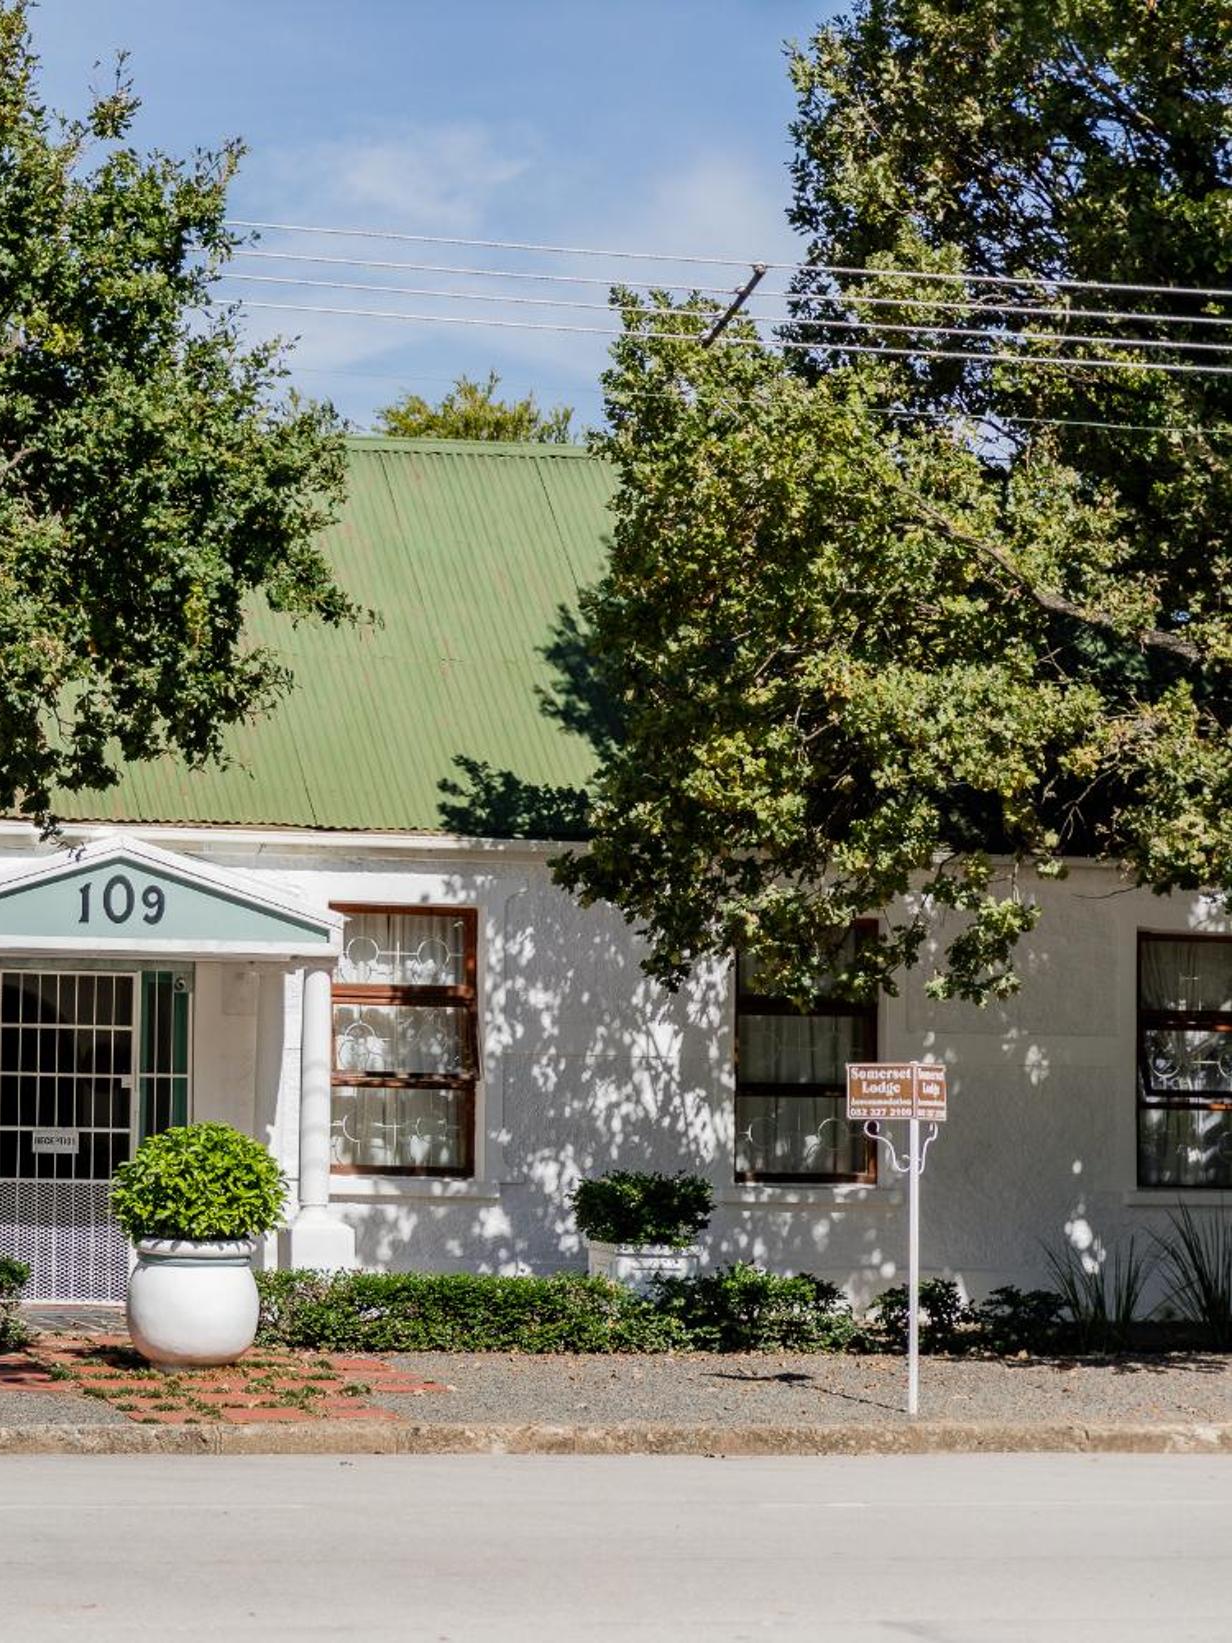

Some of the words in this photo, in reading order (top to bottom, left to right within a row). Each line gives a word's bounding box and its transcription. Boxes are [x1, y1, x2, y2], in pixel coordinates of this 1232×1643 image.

[78, 874, 165, 925] 109
[850, 1067, 912, 1079] Somerset
[862, 1081, 901, 1096] Lodge
